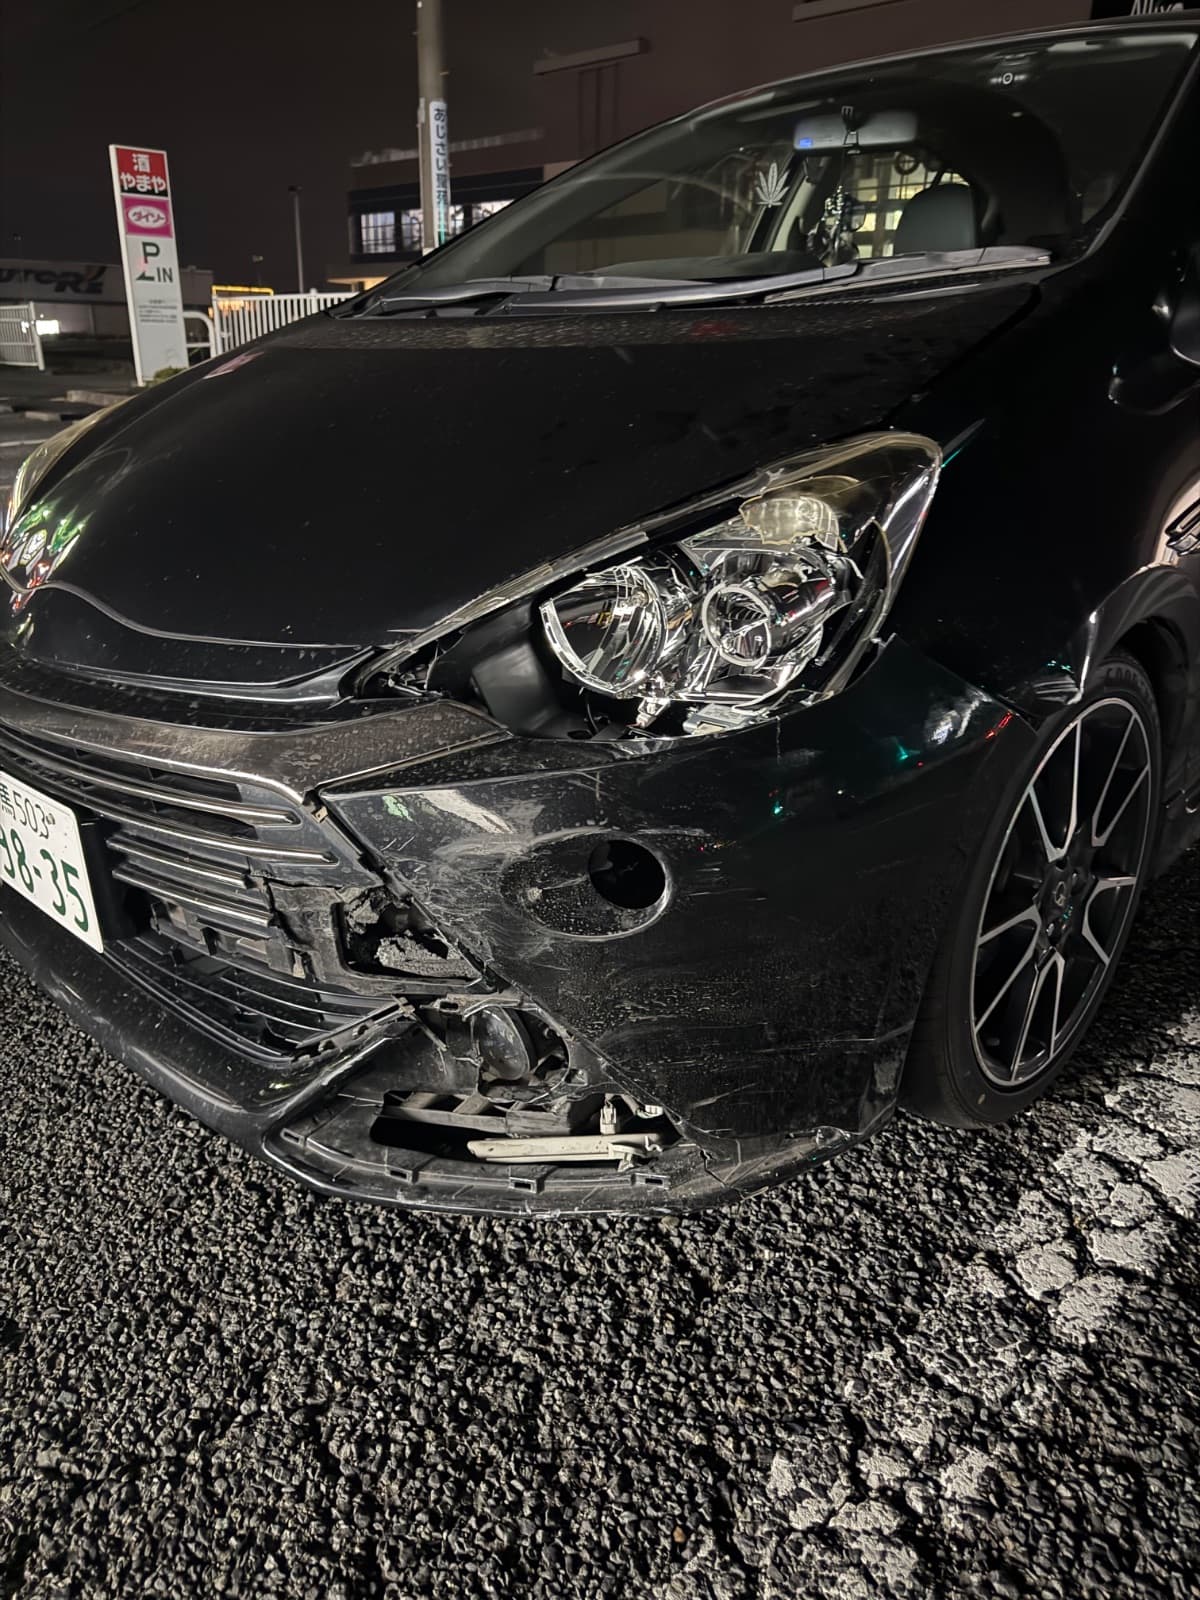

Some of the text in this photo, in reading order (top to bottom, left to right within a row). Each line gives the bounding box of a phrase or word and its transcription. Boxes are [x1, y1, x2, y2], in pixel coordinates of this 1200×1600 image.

[132, 153, 151, 172] 酒
[120, 172, 166, 193] やまや
[132, 210, 165, 224] ダイソー
[142, 241, 160, 264] P
[157, 266, 174, 283] IN
